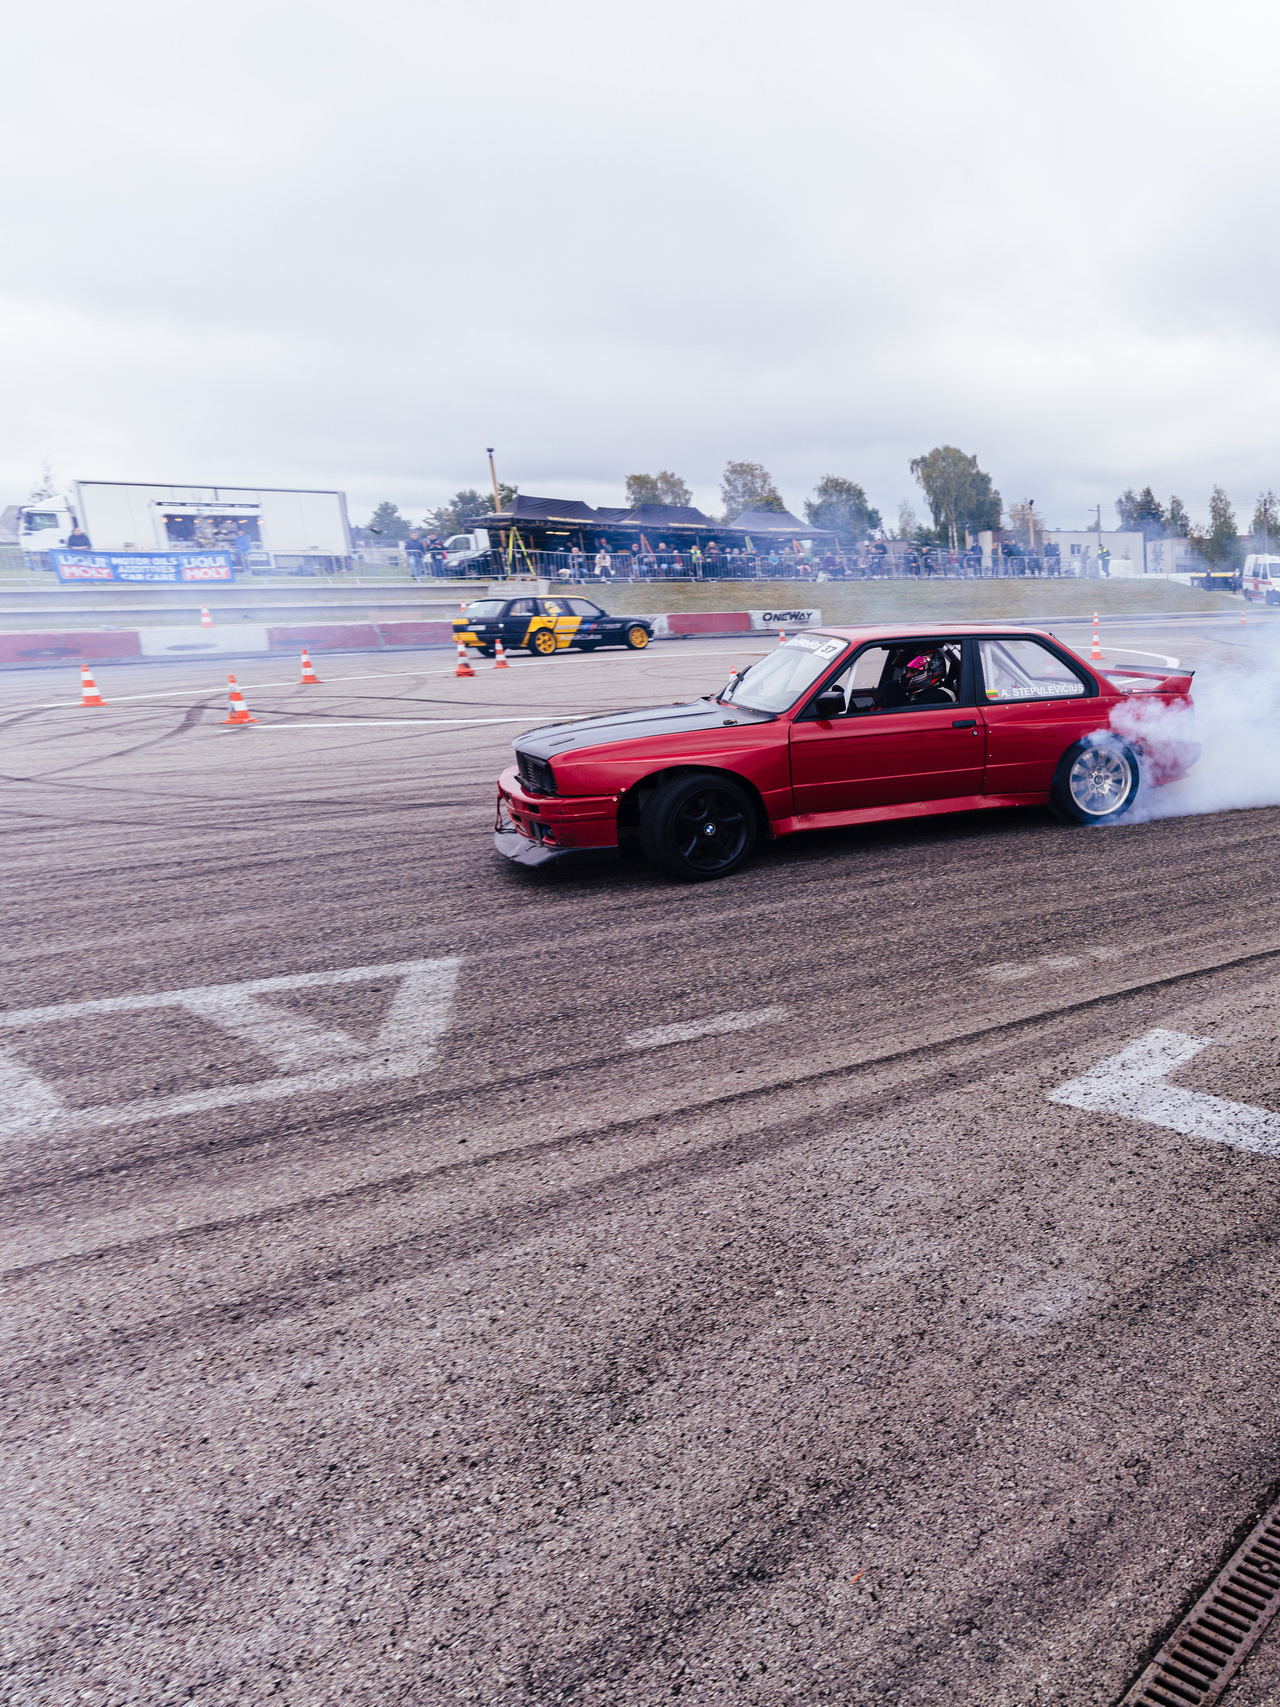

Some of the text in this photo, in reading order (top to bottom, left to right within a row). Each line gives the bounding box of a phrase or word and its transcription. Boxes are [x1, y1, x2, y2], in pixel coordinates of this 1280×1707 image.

[58, 554, 107, 568] LIQUI
[111, 557, 178, 565] MOTOR OILS
[182, 556, 226, 567] LIQUI
[62, 566, 110, 577] MOLY
[185, 567, 229, 579] MOLY
[820, 644, 837, 653] 37
[1012, 683, 1084, 696] STEPULEVIČIUS
